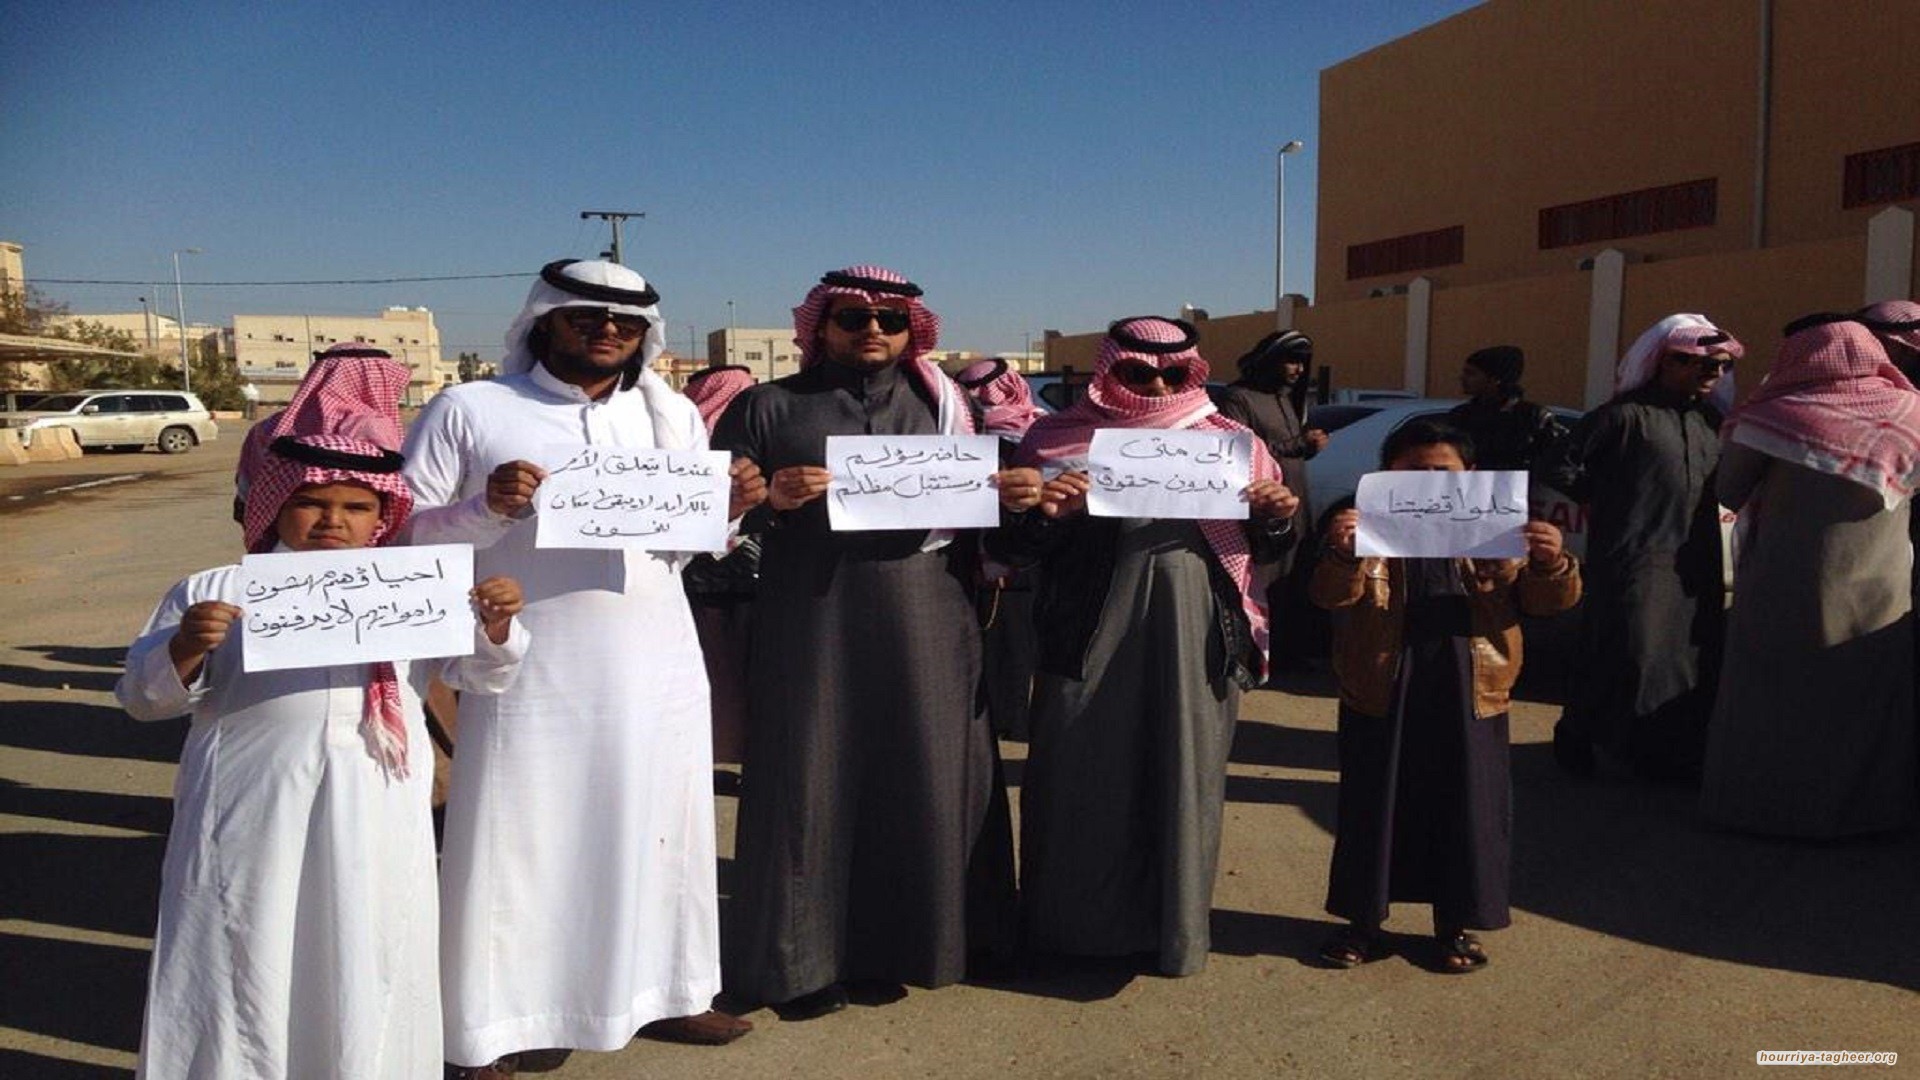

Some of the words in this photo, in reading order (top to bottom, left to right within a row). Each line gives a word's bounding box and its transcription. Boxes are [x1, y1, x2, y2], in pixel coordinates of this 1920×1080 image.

[906, 443, 982, 465] حاضر
[1120, 436, 1189, 459] متى
[603, 455, 660, 477] يتعلق
[667, 454, 714, 476] عندما
[836, 474, 891, 507] مظلم
[893, 474, 982, 498] ومستقبل
[1096, 466, 1161, 493] حقوق
[1164, 474, 1229, 494] بدون
[1389, 489, 1453, 519] قضيتنا
[1450, 487, 1522, 521] حلوا
